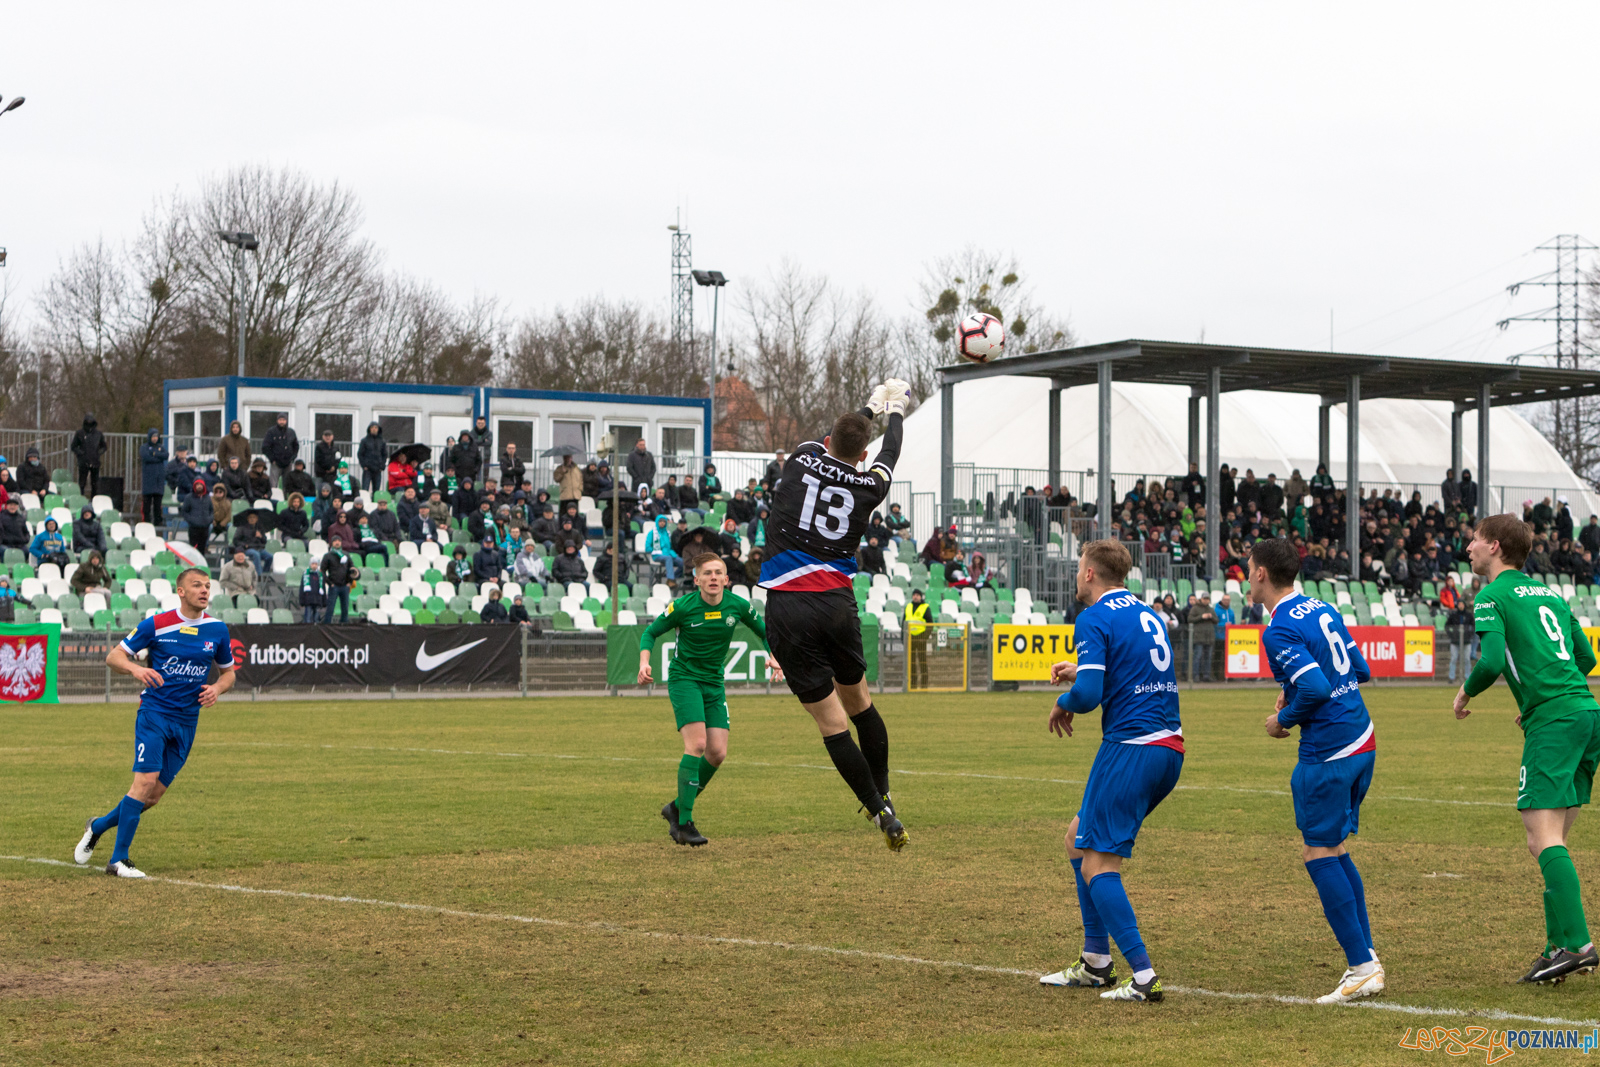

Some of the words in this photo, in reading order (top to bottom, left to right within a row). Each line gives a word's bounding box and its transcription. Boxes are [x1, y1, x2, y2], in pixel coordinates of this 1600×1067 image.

[798, 473, 855, 540] 13
[1139, 611, 1171, 672] 3
[1319, 612, 1351, 676] 6
[1370, 641, 1398, 661] LIGA
[1538, 605, 1571, 661] 9
[249, 643, 369, 669] futbolsport.pl
[137, 742, 145, 763] 2
[1519, 765, 1527, 791] 9
